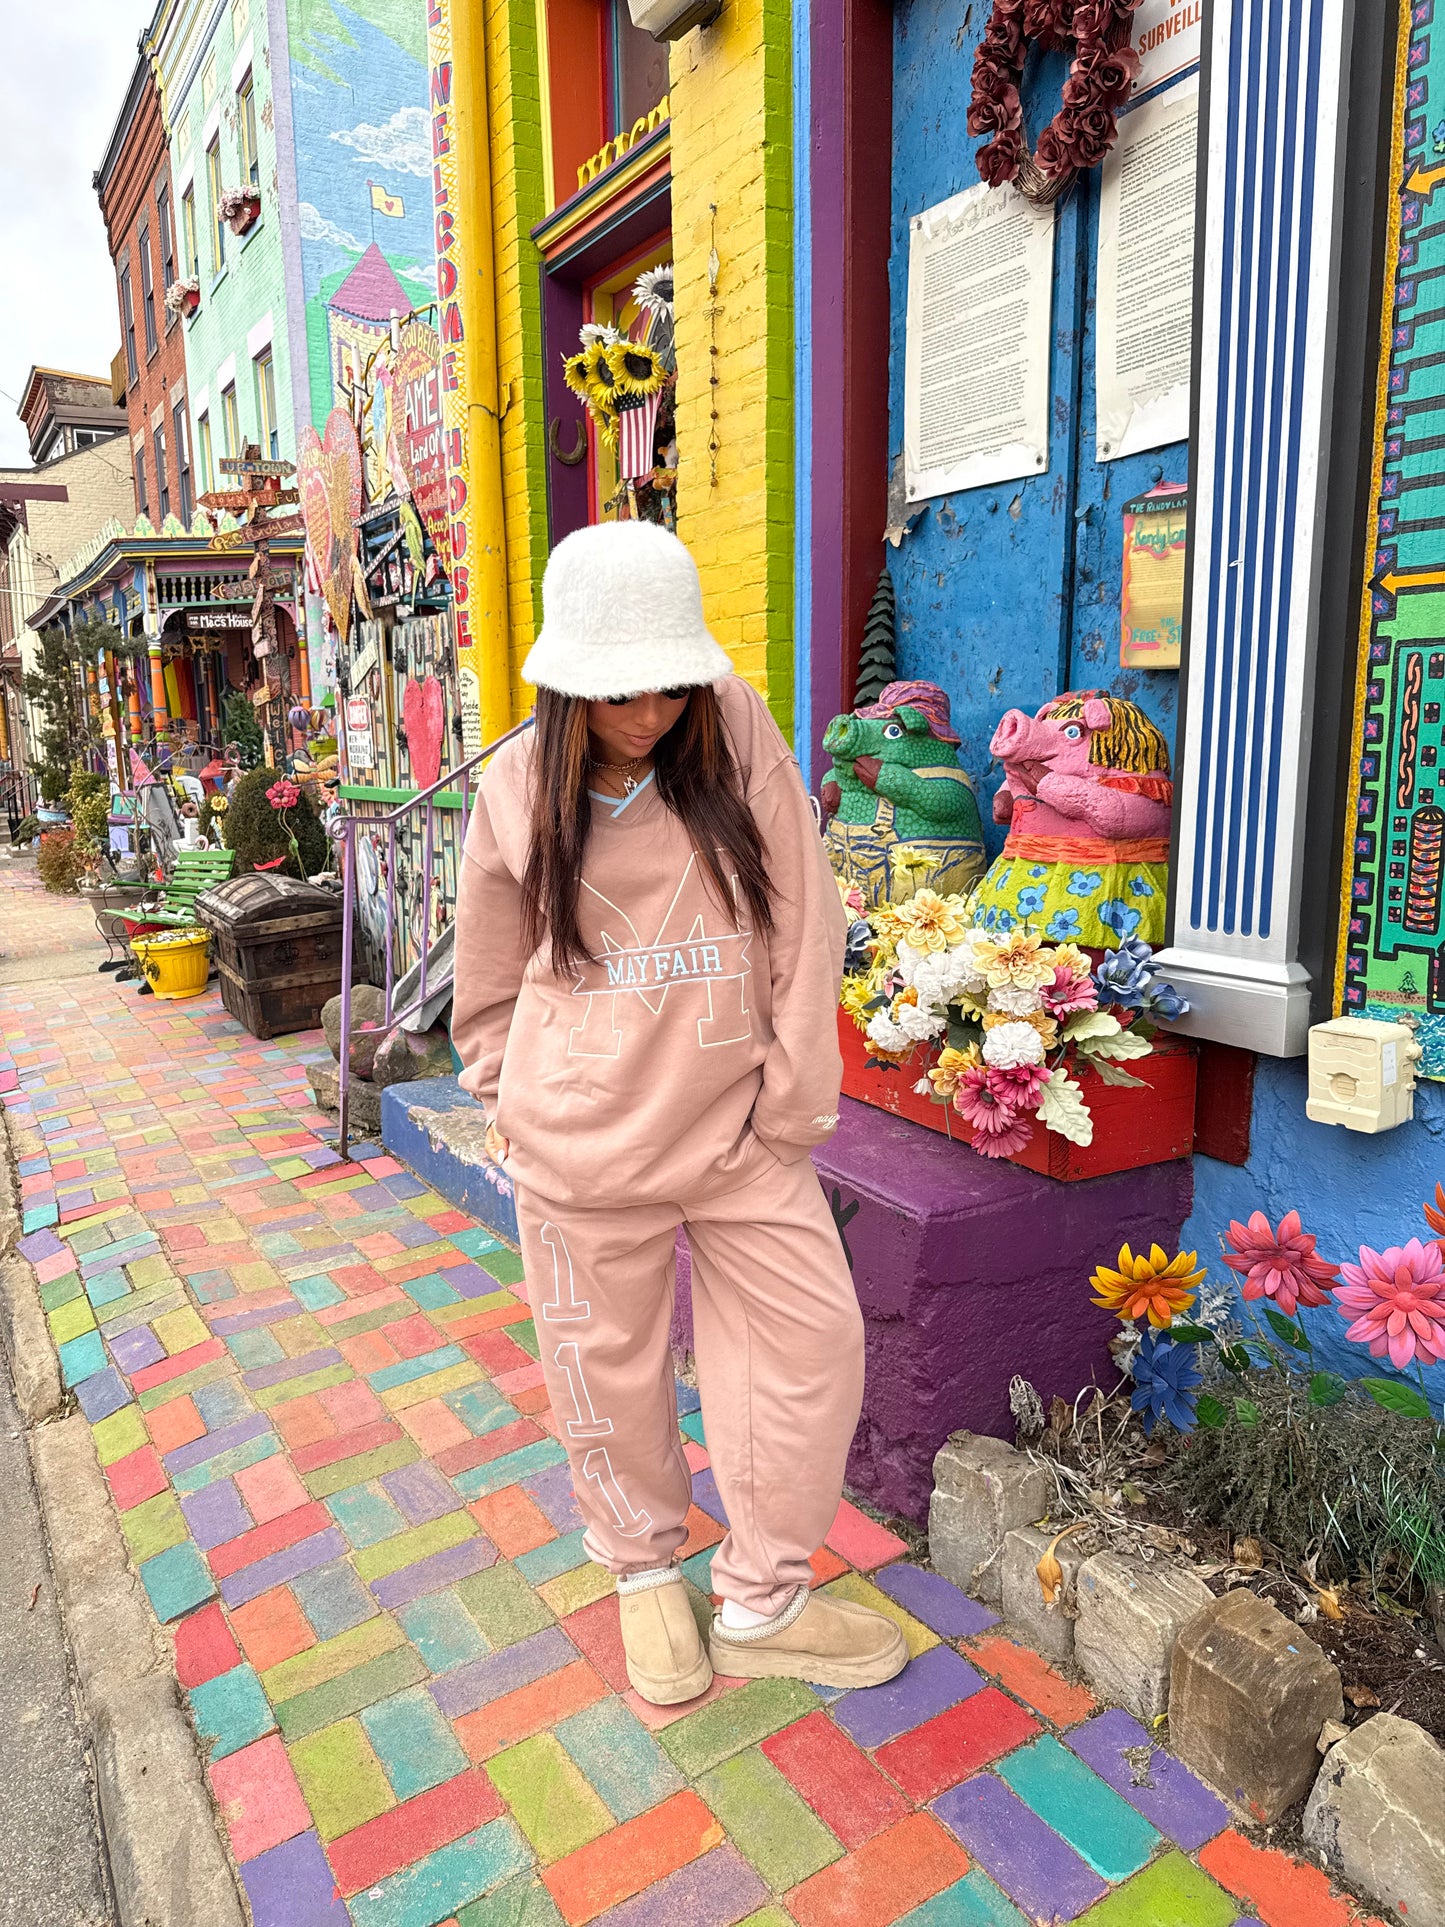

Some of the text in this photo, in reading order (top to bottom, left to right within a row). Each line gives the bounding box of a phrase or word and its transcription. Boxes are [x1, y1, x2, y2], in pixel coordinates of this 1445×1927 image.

[1138, 1, 1201, 56] SURVEILL
[1130, 502, 1146, 513] THE
[445, 427, 472, 647] HOUSE
[228, 613, 254, 628] House
[604, 945, 723, 986] MAYFAIR
